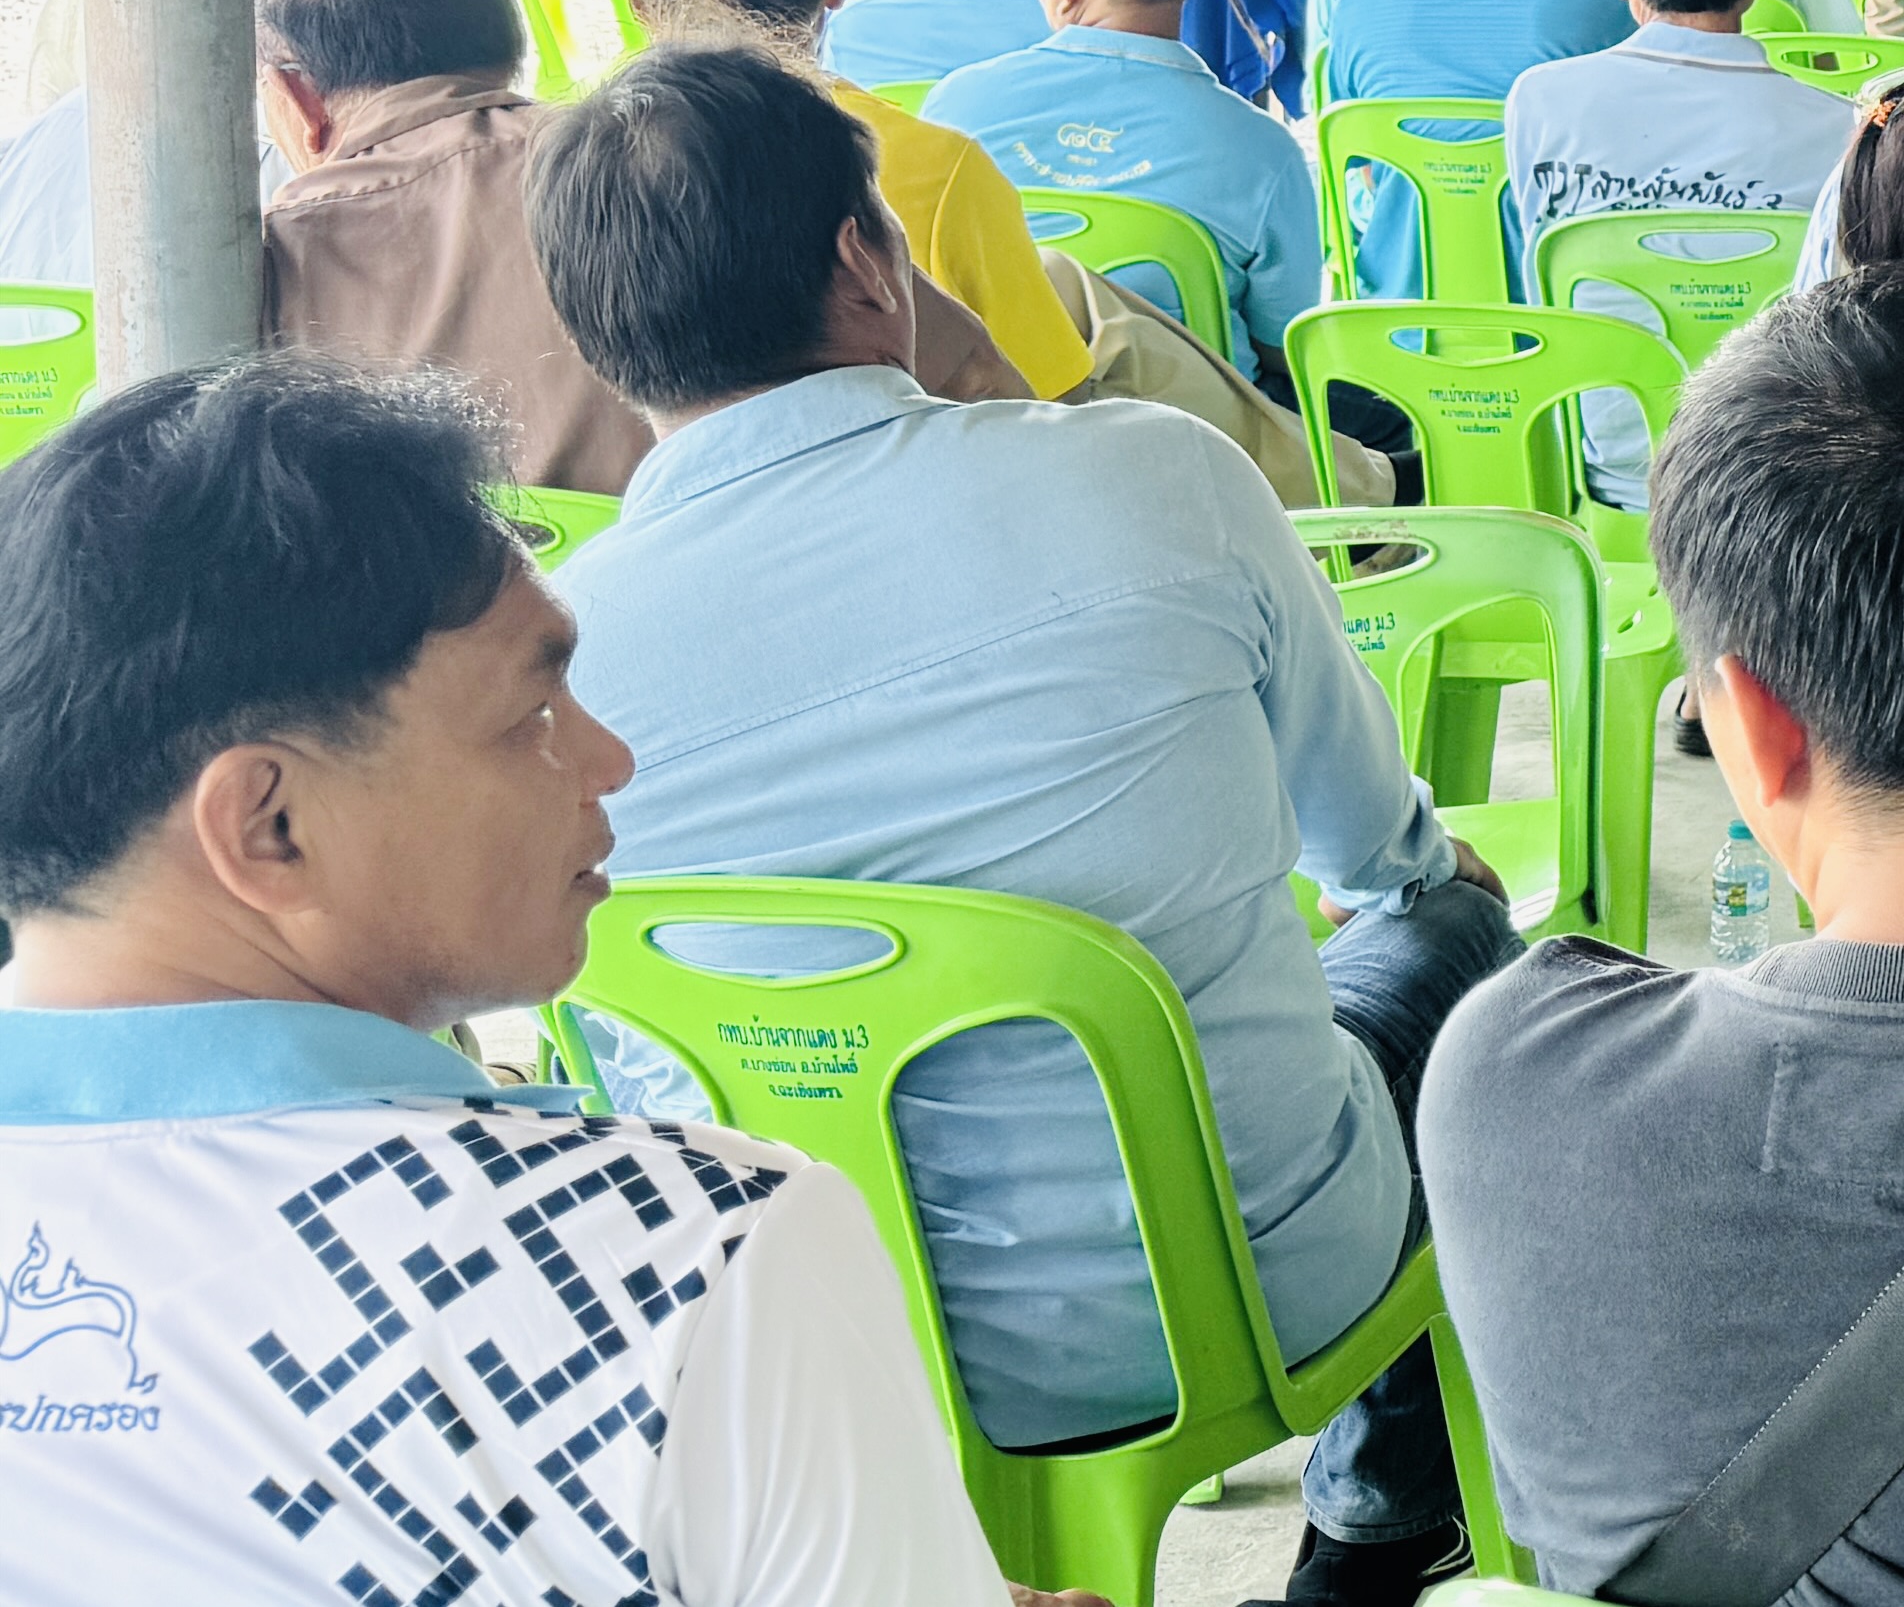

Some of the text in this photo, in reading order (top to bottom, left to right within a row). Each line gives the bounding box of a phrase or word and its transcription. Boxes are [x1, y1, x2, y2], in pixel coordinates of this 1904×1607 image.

[717, 1014, 870, 1049] กทบ.บ้านจากแดง ม.3
